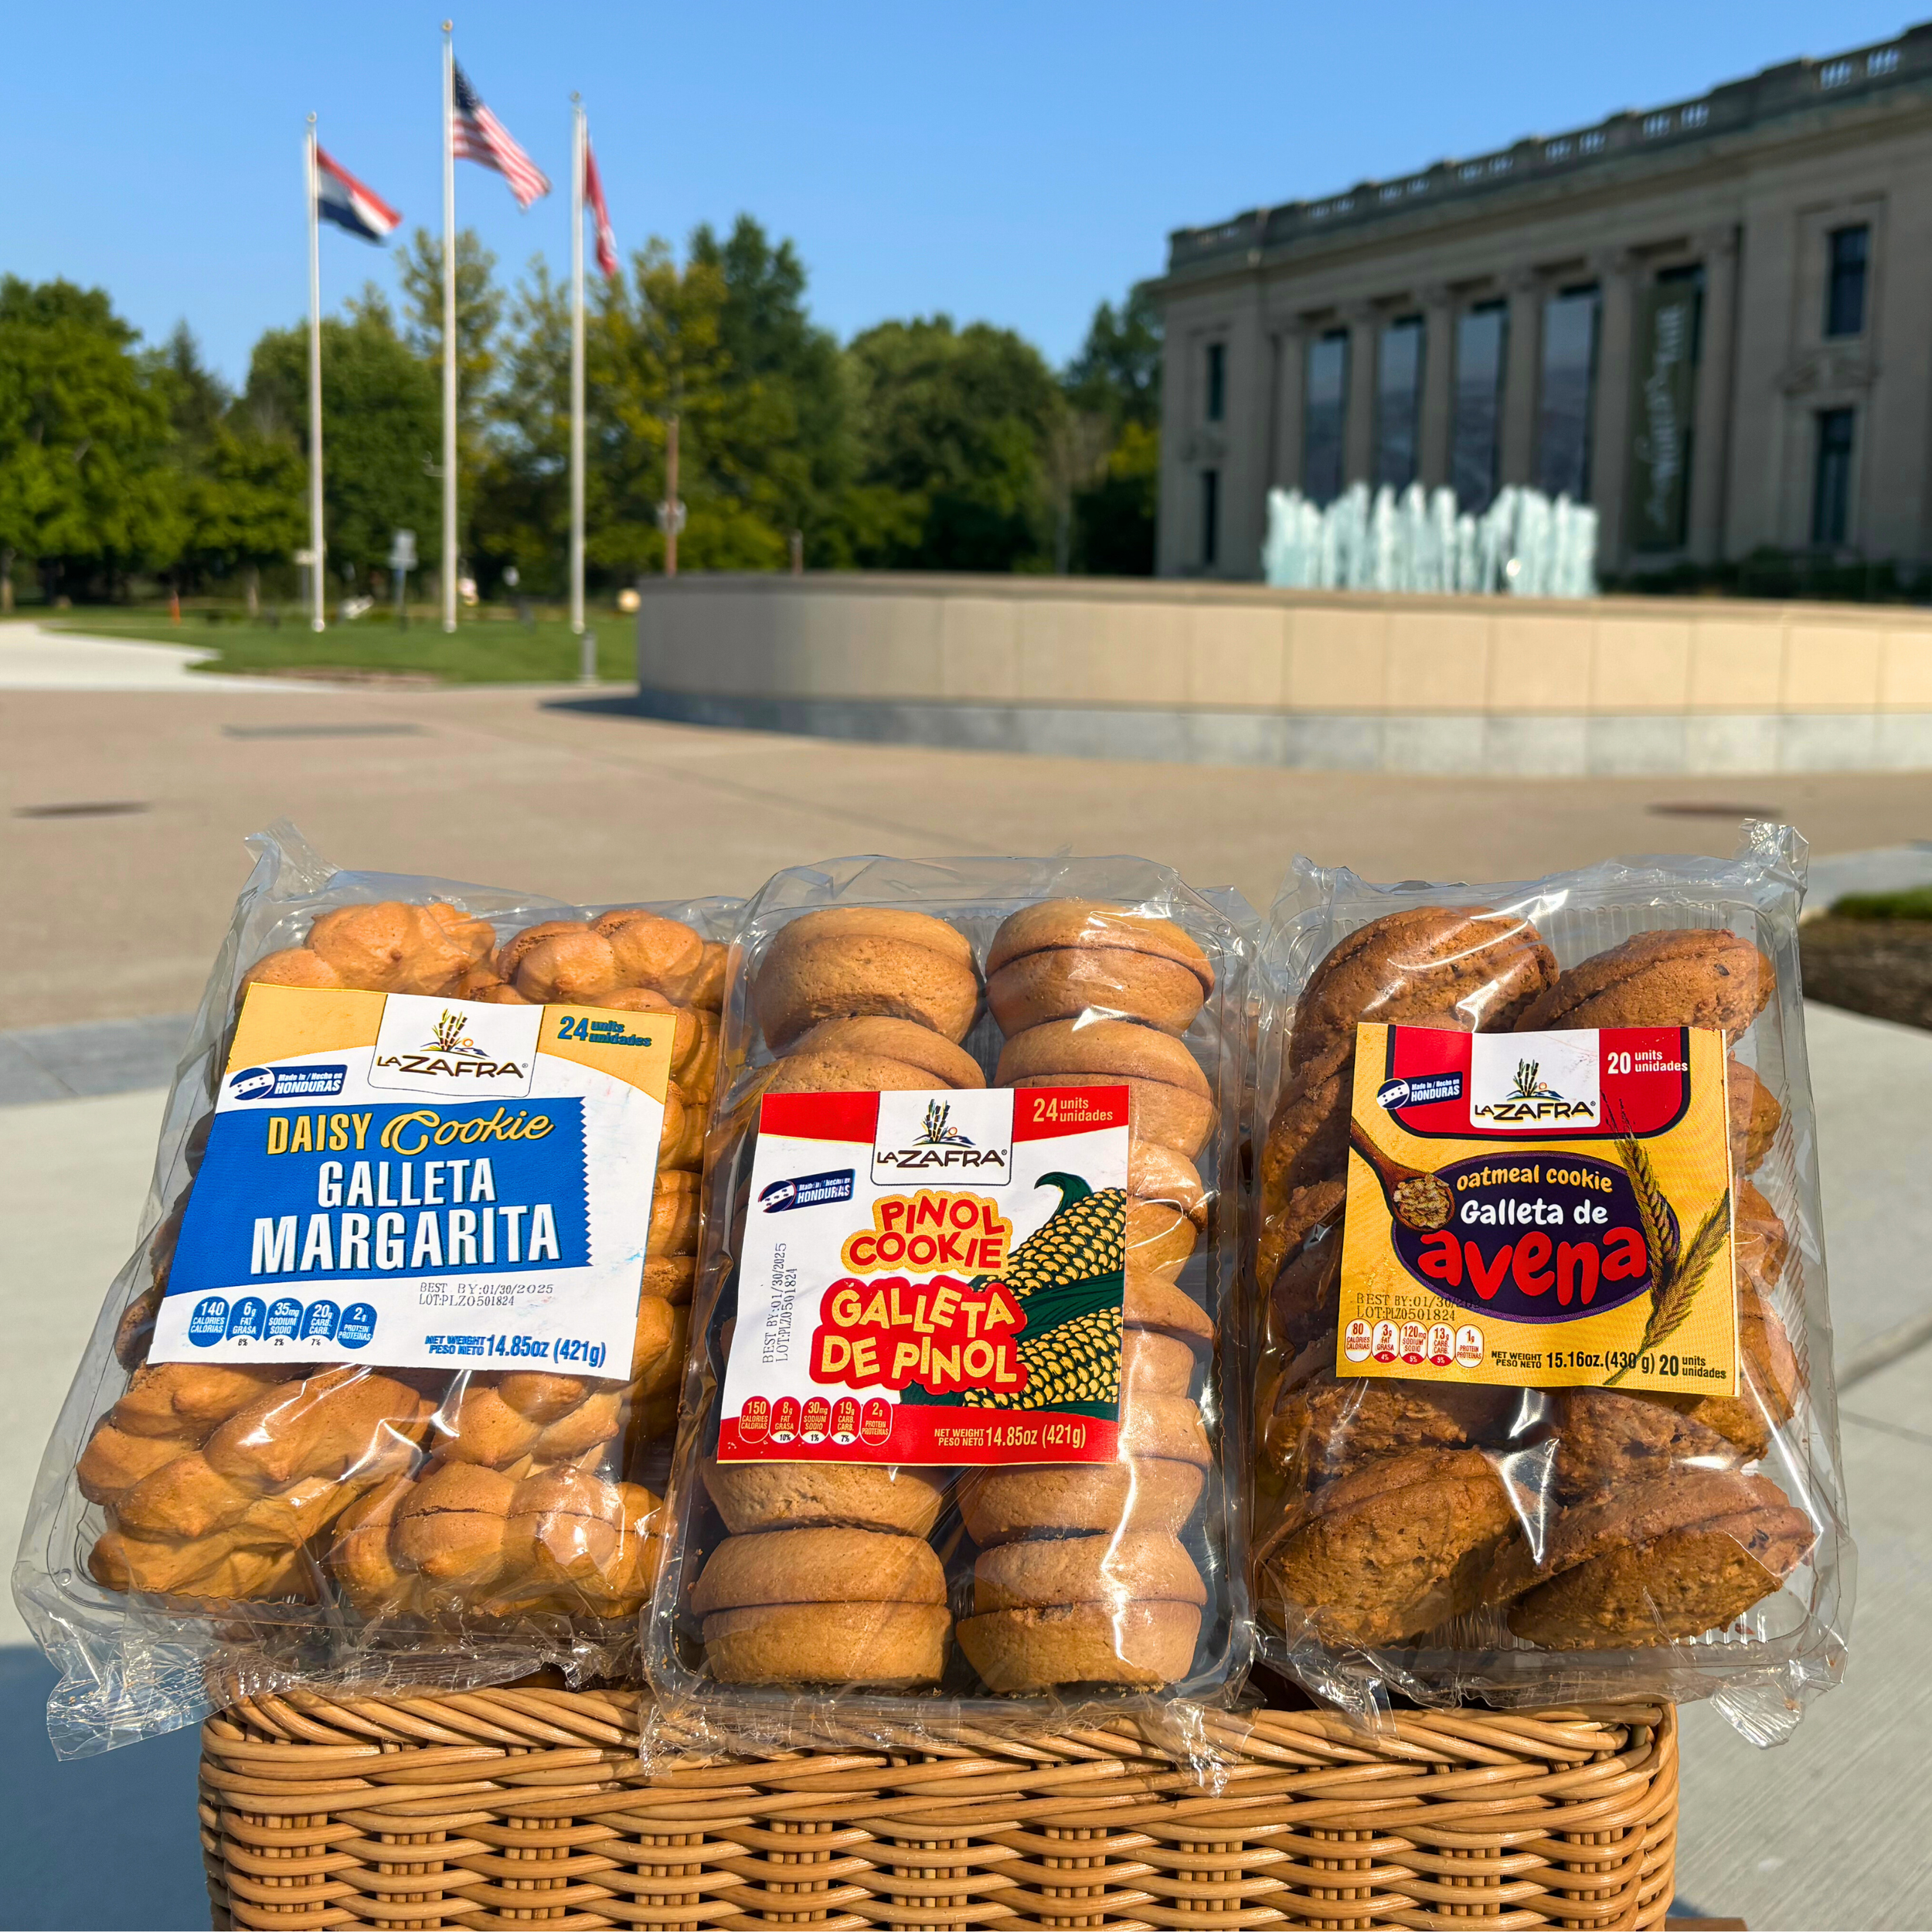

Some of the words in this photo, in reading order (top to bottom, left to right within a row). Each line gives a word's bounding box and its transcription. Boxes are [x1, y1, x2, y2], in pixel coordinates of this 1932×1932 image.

[557, 1016, 589, 1041] 24
[591, 1020, 624, 1032] units
[589, 1032, 651, 1046] unidades
[377, 1056, 401, 1067] LA
[399, 1055, 524, 1079] ZAFRA
[1607, 1052, 1631, 1074] 20
[1634, 1050, 1663, 1061] units
[1634, 1060, 1688, 1072] unidades
[274, 1080, 342, 1094] HONDURAS
[1411, 1085, 1460, 1102] HONDURAS
[1033, 1097, 1058, 1122] 24
[1060, 1097, 1089, 1109] units
[1060, 1110, 1113, 1122] unidades
[1475, 1104, 1495, 1116] LA
[1494, 1101, 1594, 1121] ZAFRA
[267, 1112, 373, 1155] DAISY
[380, 1107, 555, 1155] Cookie
[877, 1151, 899, 1163] LA
[896, 1149, 1005, 1168] ZAFRA
[318, 1157, 498, 1208] GALLETA
[1457, 1165, 1539, 1191] oatmeal
[1546, 1168, 1613, 1193] cookie
[797, 1185, 851, 1204] HONDURAS
[880, 1196, 1005, 1235] PINOL
[1461, 1198, 1563, 1225] Galleta
[1573, 1199, 1608, 1224] de
[250, 1203, 562, 1275] MARGARITA
[849, 1231, 1003, 1269] COOKIE
[1417, 1226, 1647, 1306] avena
[420, 1282, 447, 1294] BEST
[458, 1284, 554, 1295] BY:01/30/2025
[767, 1243, 787, 1327] BY:01/30/2025
[1357, 1293, 1389, 1305] BEST
[201, 1301, 225, 1316] 140
[243, 1301, 256, 1317] 6g
[275, 1302, 300, 1317] 35mg
[312, 1304, 333, 1319] 20g
[353, 1307, 366, 1322] 2g
[832, 1286, 1015, 1338] GALLETA
[193, 1317, 225, 1325] CALORIES
[240, 1318, 253, 1326] FAT
[269, 1318, 296, 1326] SODIUM
[191, 1325, 224, 1333] CALORIAS
[233, 1325, 257, 1334] GRASA
[270, 1326, 291, 1335] SODIO
[309, 1326, 329, 1335] CARB.
[1352, 1323, 1364, 1335] 80
[1383, 1325, 1392, 1337] 3g
[1404, 1326, 1427, 1339] 120mg
[1434, 1328, 1450, 1341] 13g
[1467, 1329, 1475, 1343] 1g
[425, 1335, 445, 1345] NET
[447, 1335, 486, 1345] WEIGHT
[429, 1345, 456, 1354] PESO
[457, 1345, 485, 1355] NETO
[486, 1335, 550, 1357] 14.85oz
[553, 1338, 606, 1368] (421g)
[762, 1332, 777, 1363] BEST
[821, 1335, 880, 1378] DE
[891, 1336, 1017, 1385] PINOL
[1492, 1351, 1508, 1359] NET
[1509, 1352, 1543, 1361] WEIGHT
[1496, 1358, 1518, 1367] PESO
[1520, 1359, 1542, 1369] NETO
[1659, 1355, 1679, 1376] 20
[1682, 1355, 1706, 1366] units
[1682, 1366, 1727, 1379] unidades
[747, 1402, 767, 1415] 150
[782, 1402, 793, 1415] 8g
[808, 1402, 828, 1415] 30mg
[840, 1402, 855, 1416] 19g
[872, 1403, 883, 1417] 2g
[934, 1428, 951, 1437] NET
[952, 1428, 985, 1437] WEIGHT
[986, 1426, 1038, 1447] 14.85oz
[1043, 1423, 1087, 1449] (421g)
[938, 1437, 960, 1446] PESO
[962, 1437, 984, 1446] NETO
